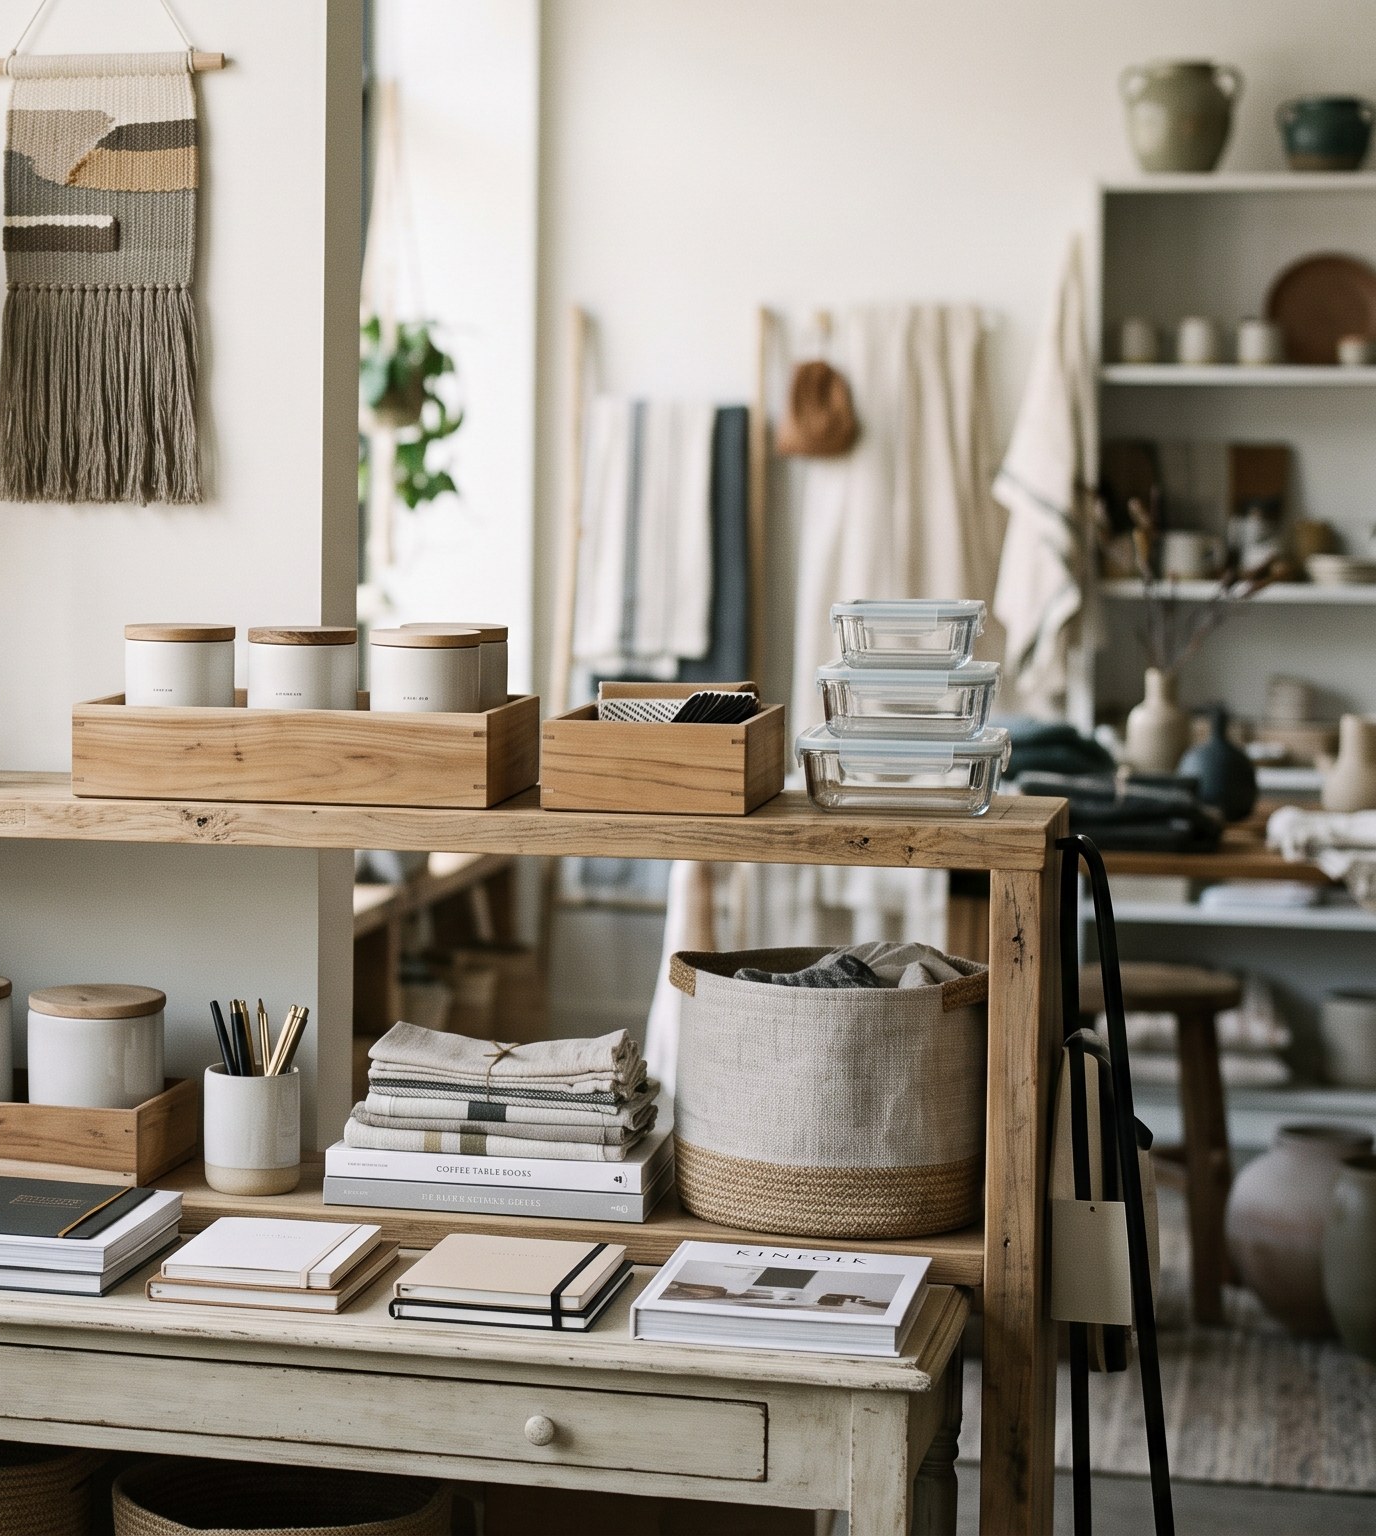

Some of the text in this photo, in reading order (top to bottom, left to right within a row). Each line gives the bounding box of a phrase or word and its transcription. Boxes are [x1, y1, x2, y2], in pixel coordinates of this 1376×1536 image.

[436, 1165, 470, 1175] COFFEE
[472, 1167, 500, 1176] TABLE
[736, 1249, 867, 1265] KINFOLK
